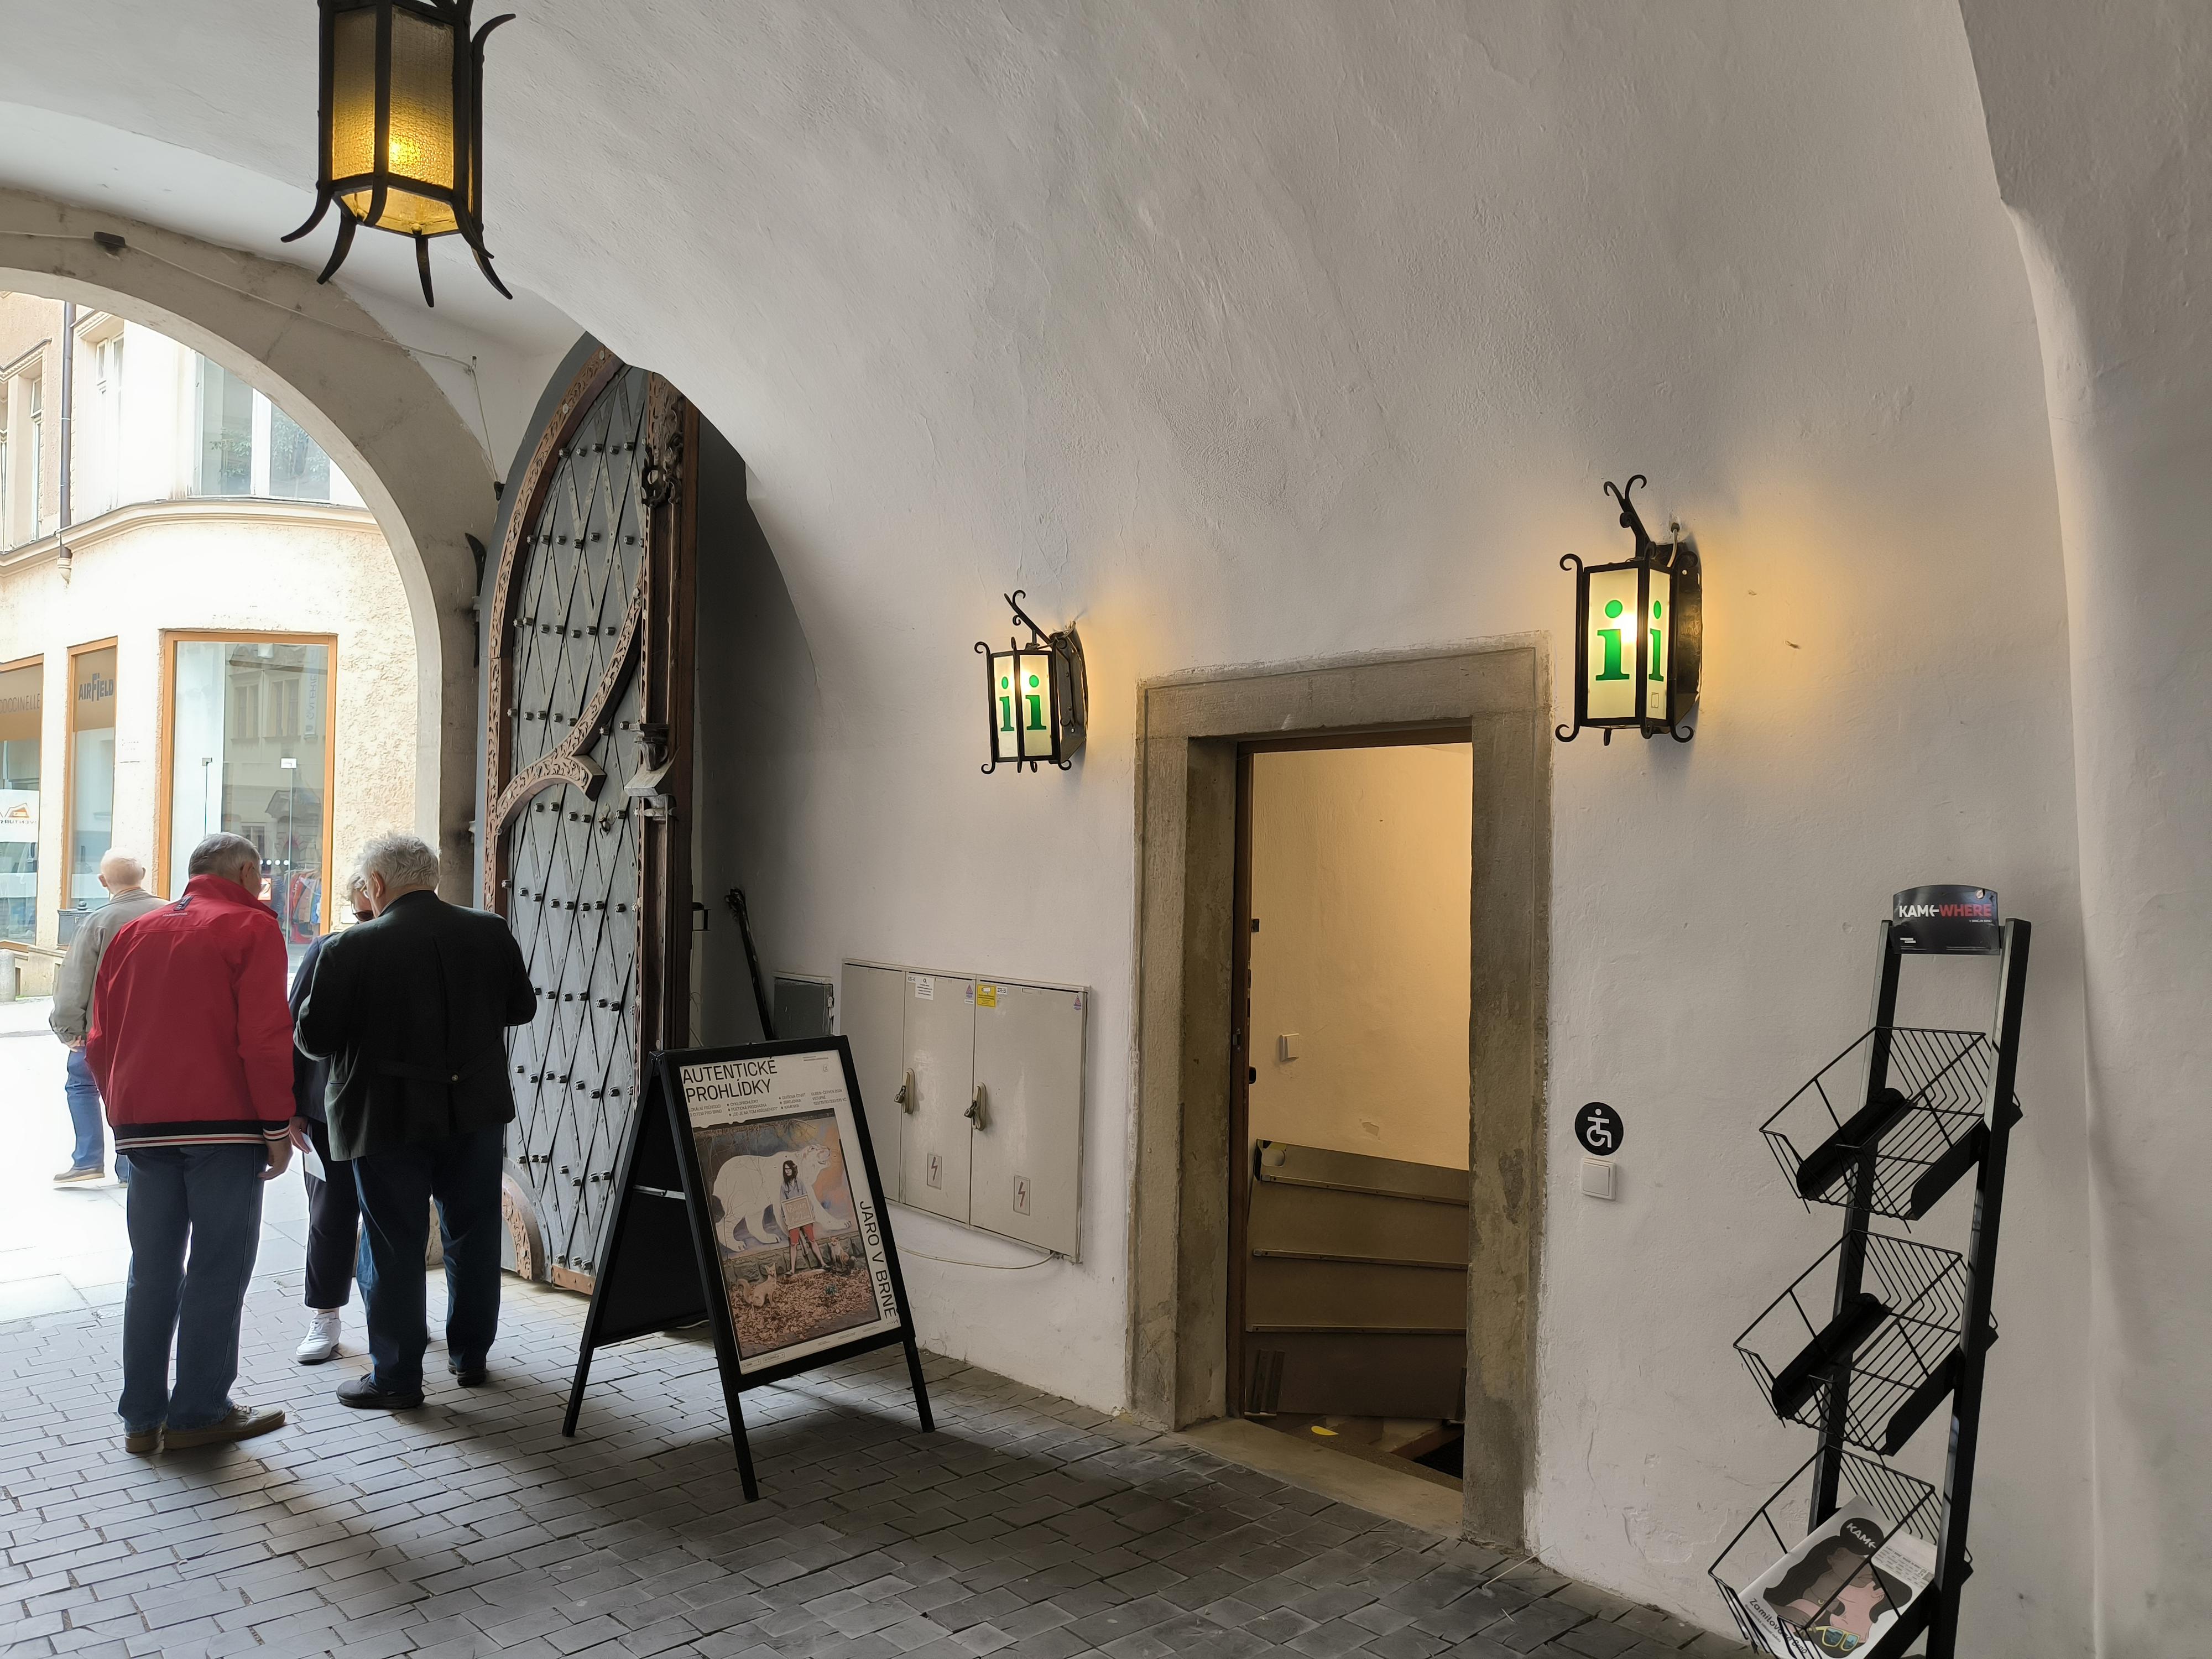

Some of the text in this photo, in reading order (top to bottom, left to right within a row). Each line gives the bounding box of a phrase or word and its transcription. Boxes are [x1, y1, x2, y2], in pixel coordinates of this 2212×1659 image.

[683, 1056, 778, 1084] AUTENTICKÉ
[686, 1078, 770, 1103] PROHLÍDKY
[860, 1201, 880, 1246] JARO
[872, 1251, 884, 1263] V
